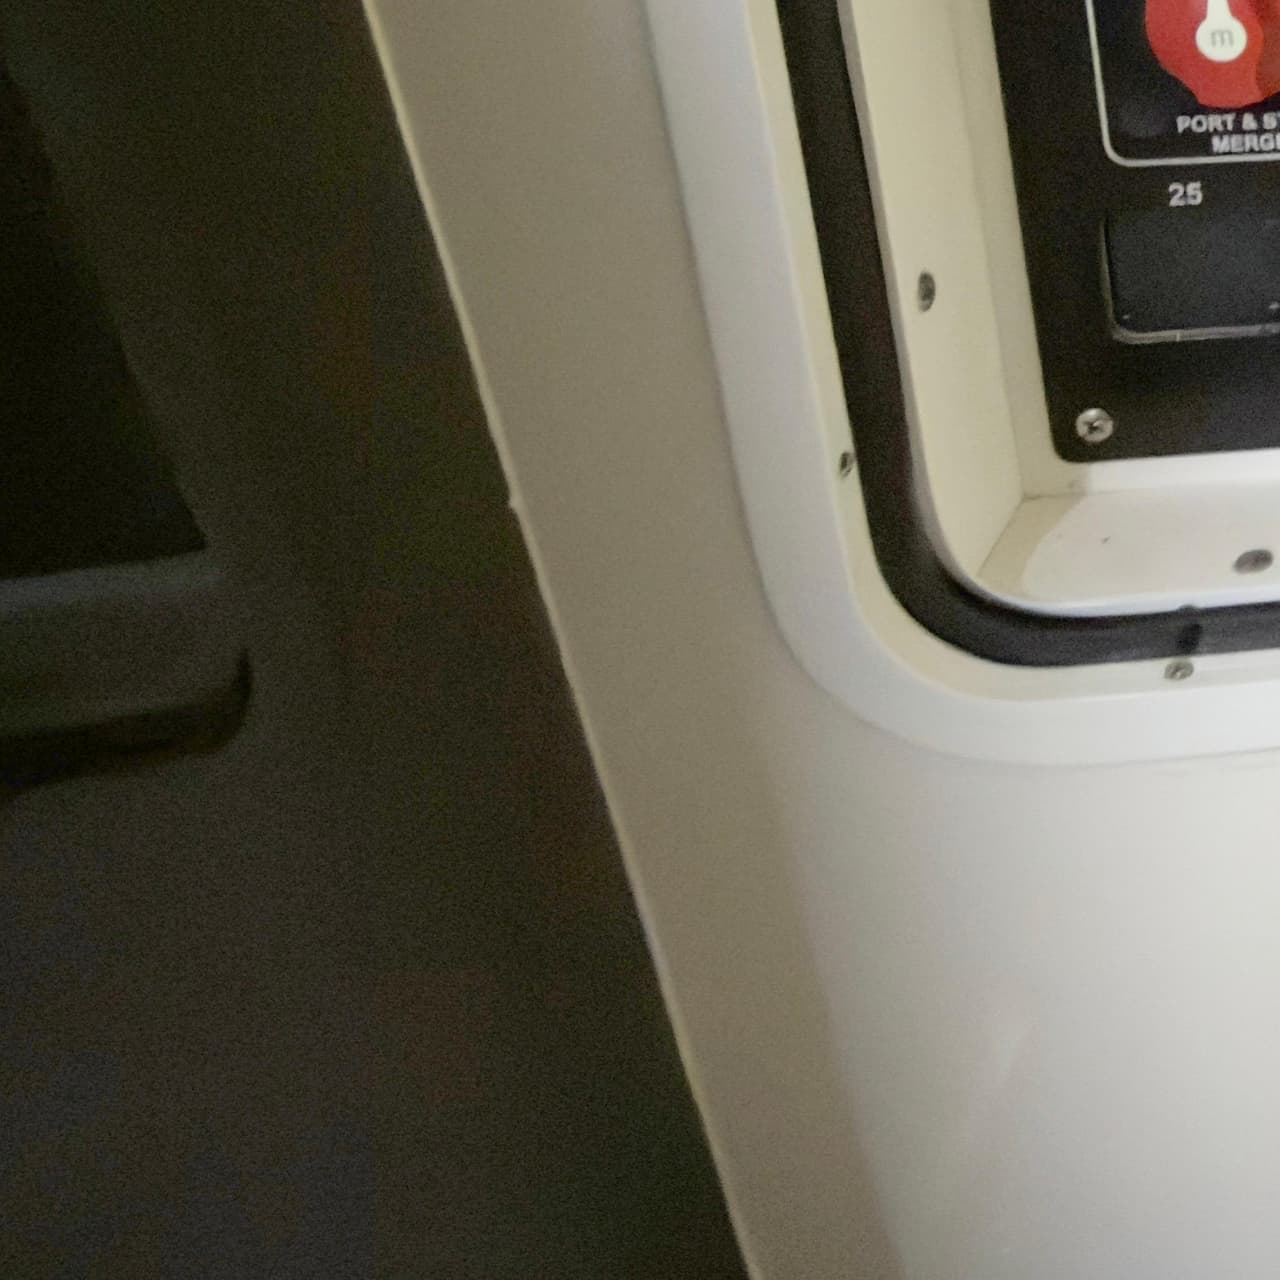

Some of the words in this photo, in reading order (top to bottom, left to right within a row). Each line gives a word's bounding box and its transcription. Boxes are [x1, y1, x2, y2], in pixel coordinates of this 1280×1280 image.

[1176, 113, 1234, 133] PORT
[1242, 112, 1259, 131] &
[1168, 183, 1203, 206] 25
